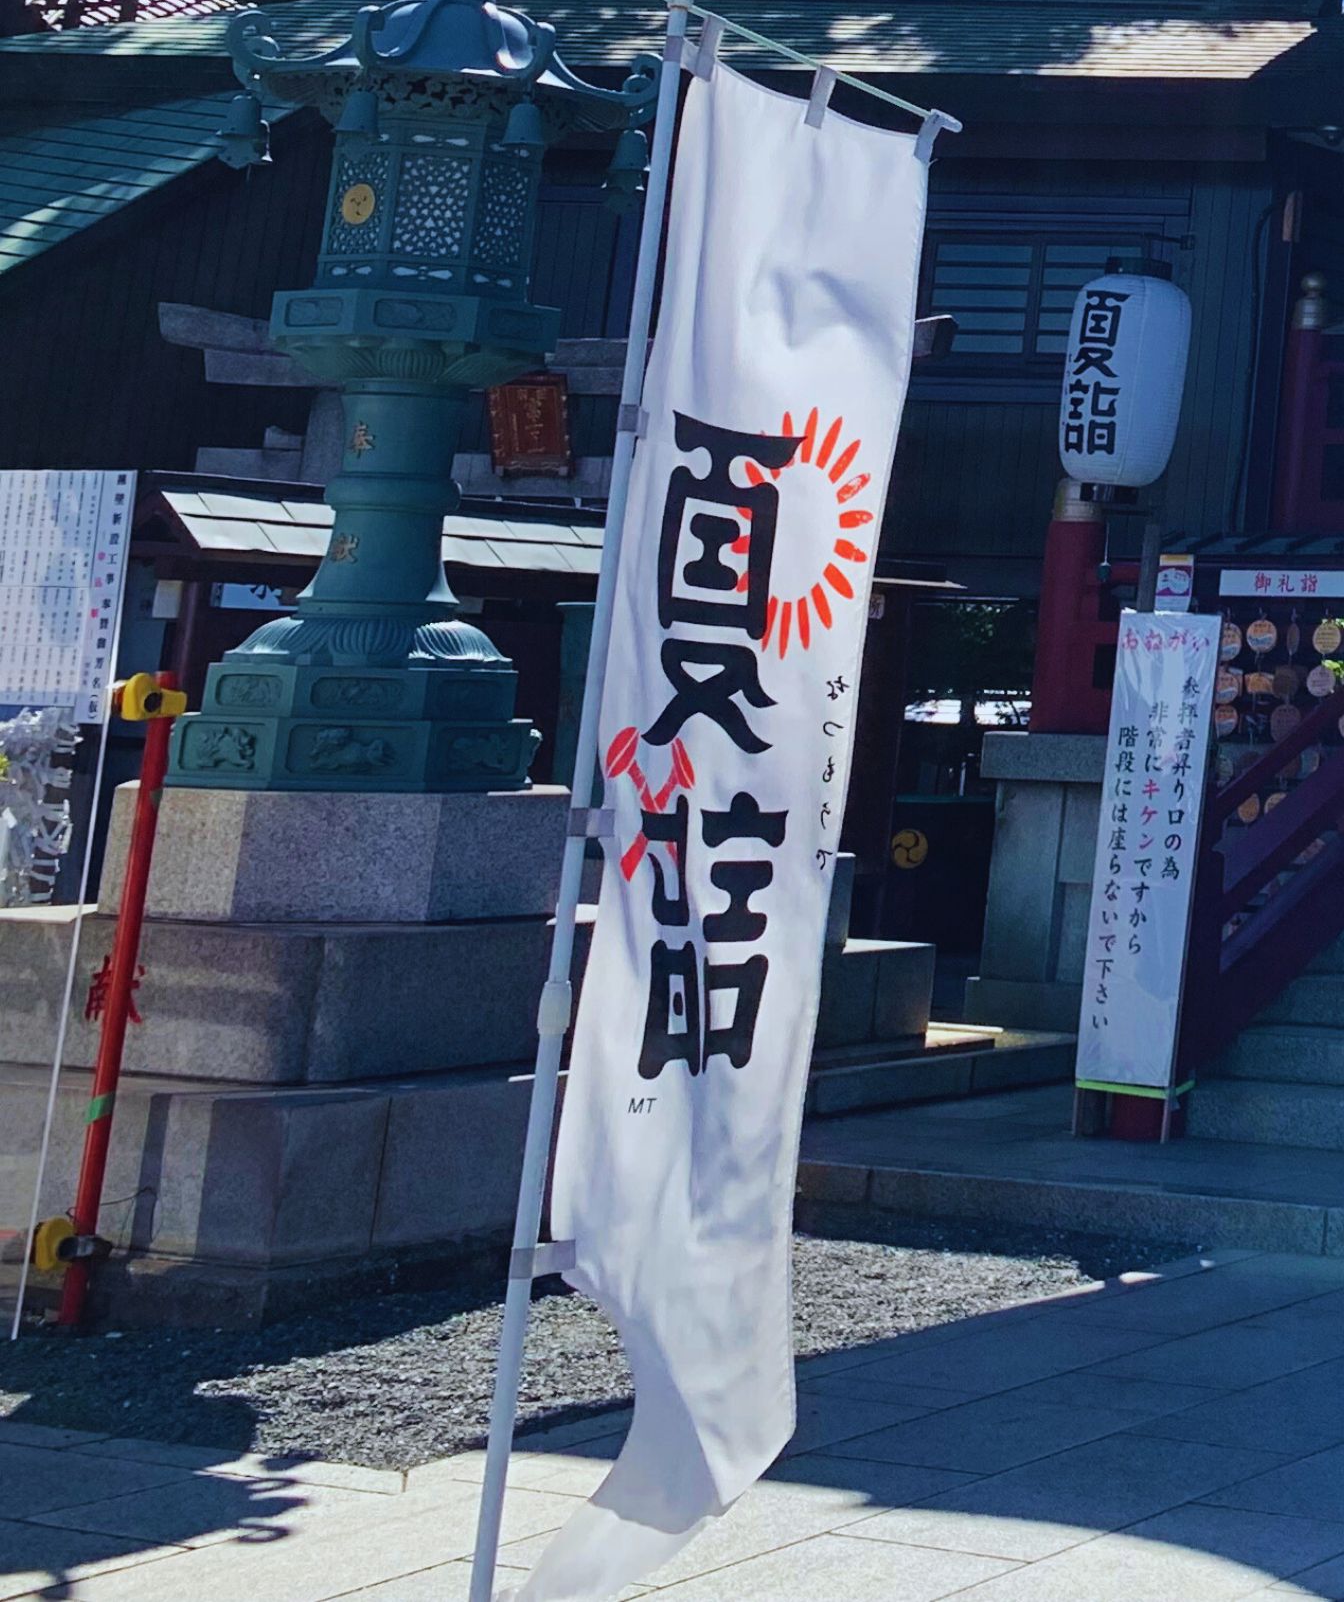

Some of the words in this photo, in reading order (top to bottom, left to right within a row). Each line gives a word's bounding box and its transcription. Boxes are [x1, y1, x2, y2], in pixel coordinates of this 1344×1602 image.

[1064, 289, 1134, 455] 夏詣
[1254, 572, 1318, 593] 御礼詣
[1091, 726, 1139, 1030] 階段には座らないで下さい
[1128, 702, 1169, 955] 非常にキケンですから
